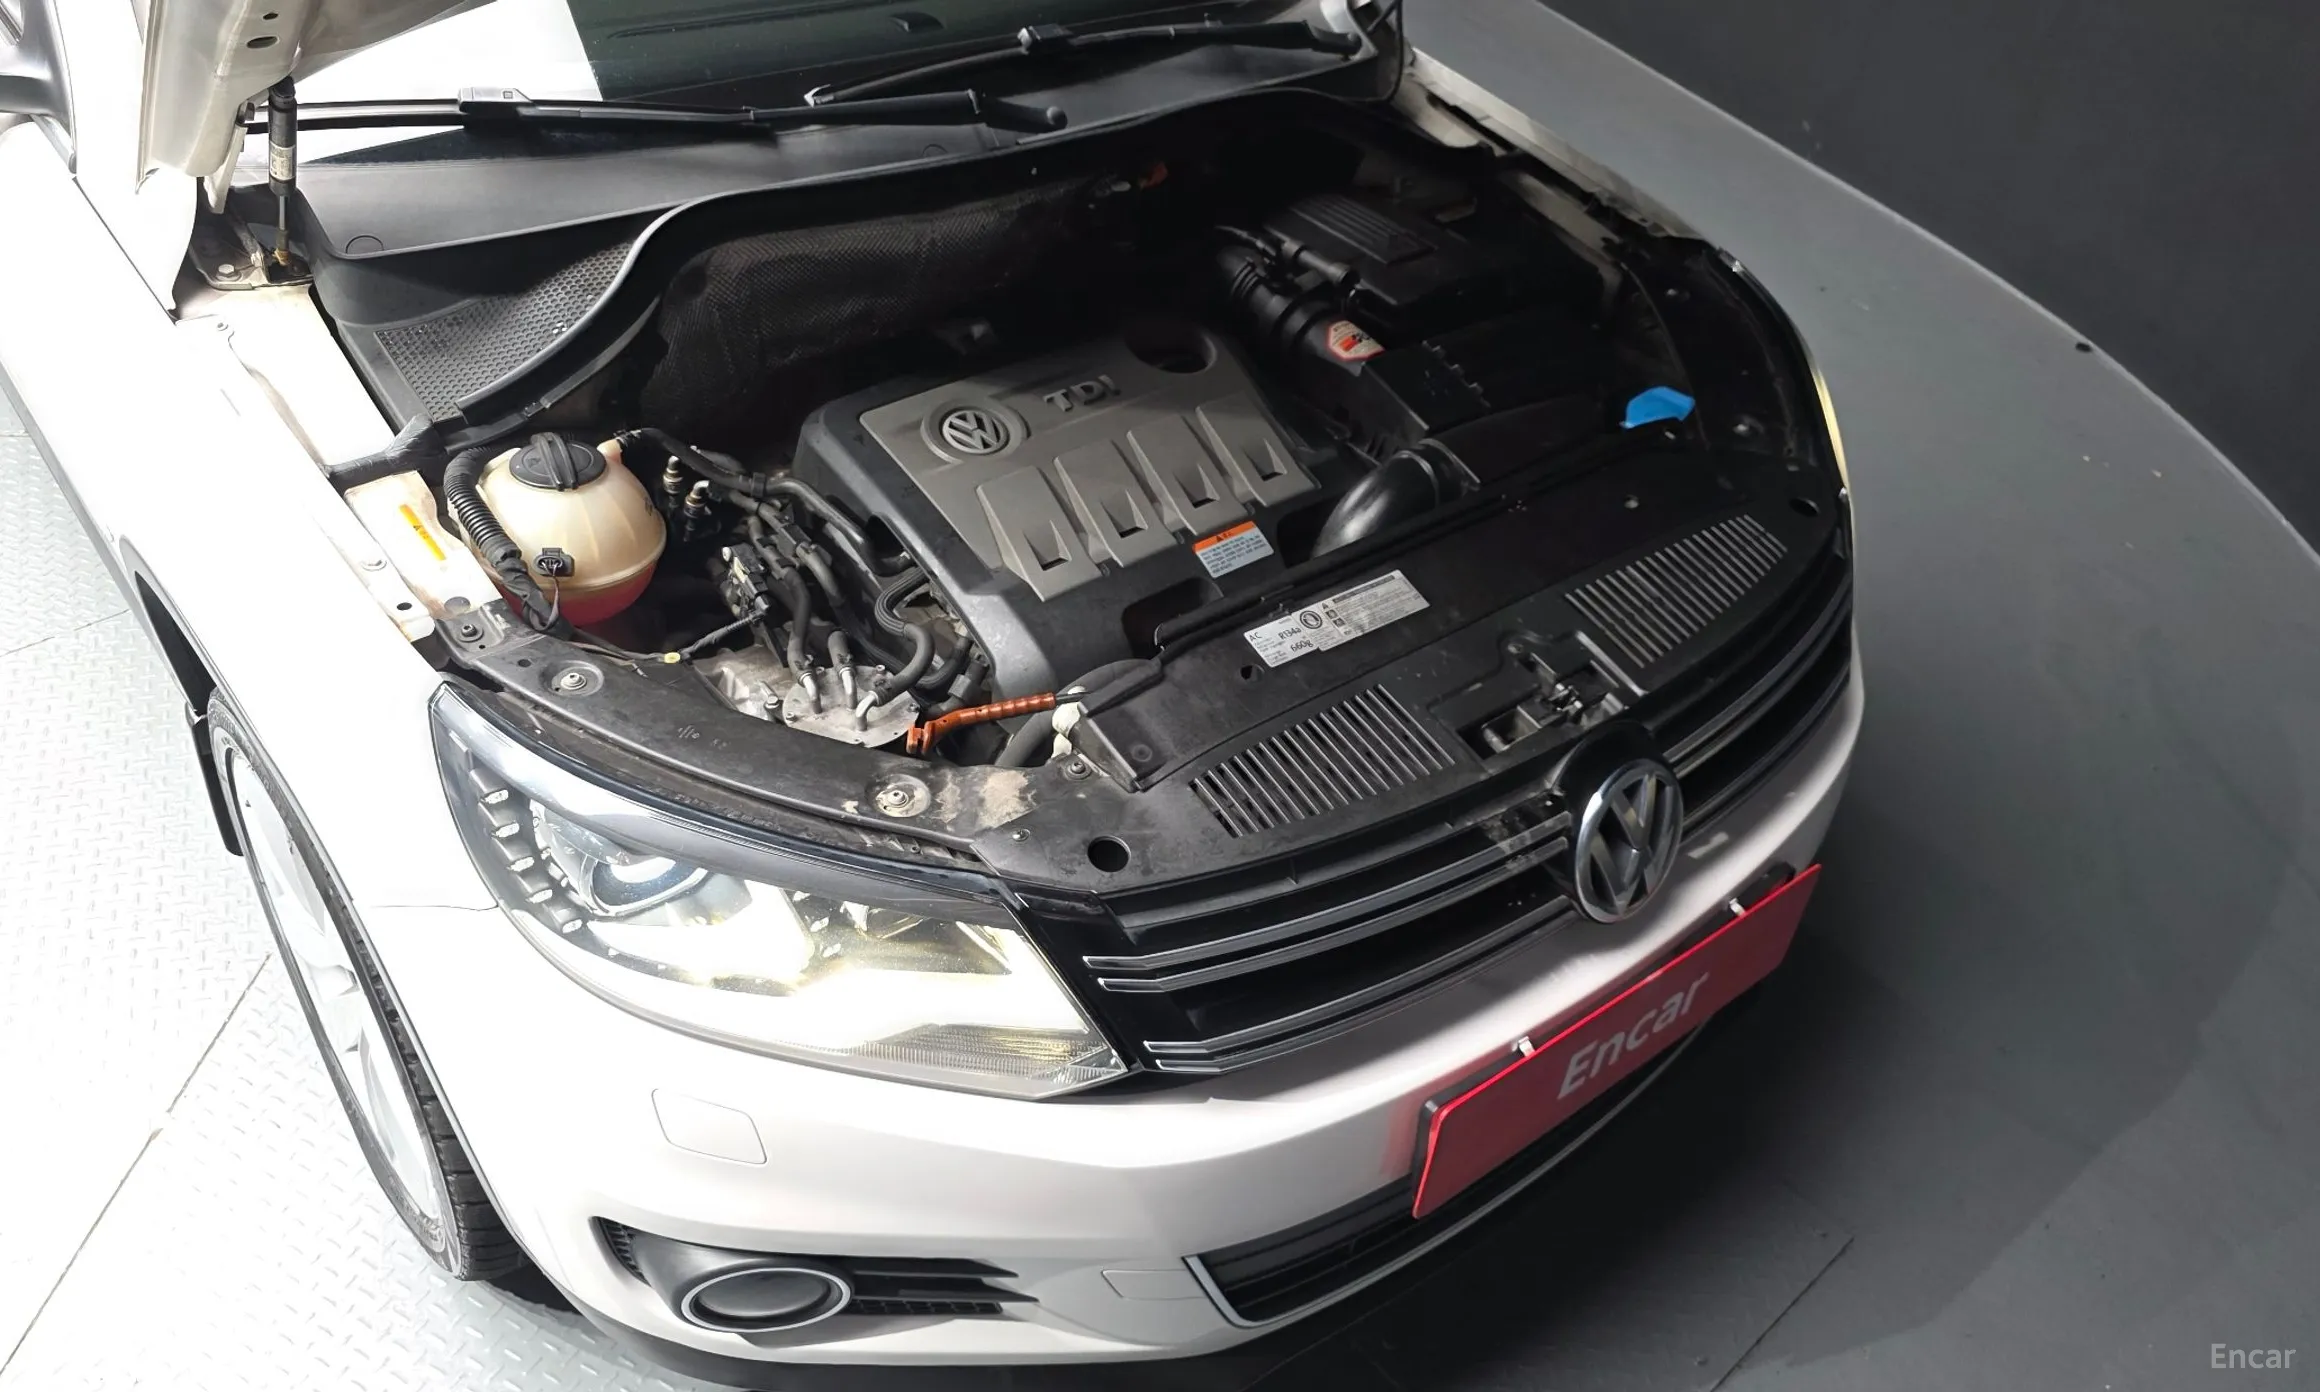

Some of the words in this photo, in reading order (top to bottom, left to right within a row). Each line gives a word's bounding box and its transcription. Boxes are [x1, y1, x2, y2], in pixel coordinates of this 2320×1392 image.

[1042, 374, 1117, 412] TDI
[942, 410, 1008, 454] VW
[1278, 627, 1302, 640] R134a
[1290, 640, 1314, 652] 660g
[1556, 971, 1710, 1100] Encar
